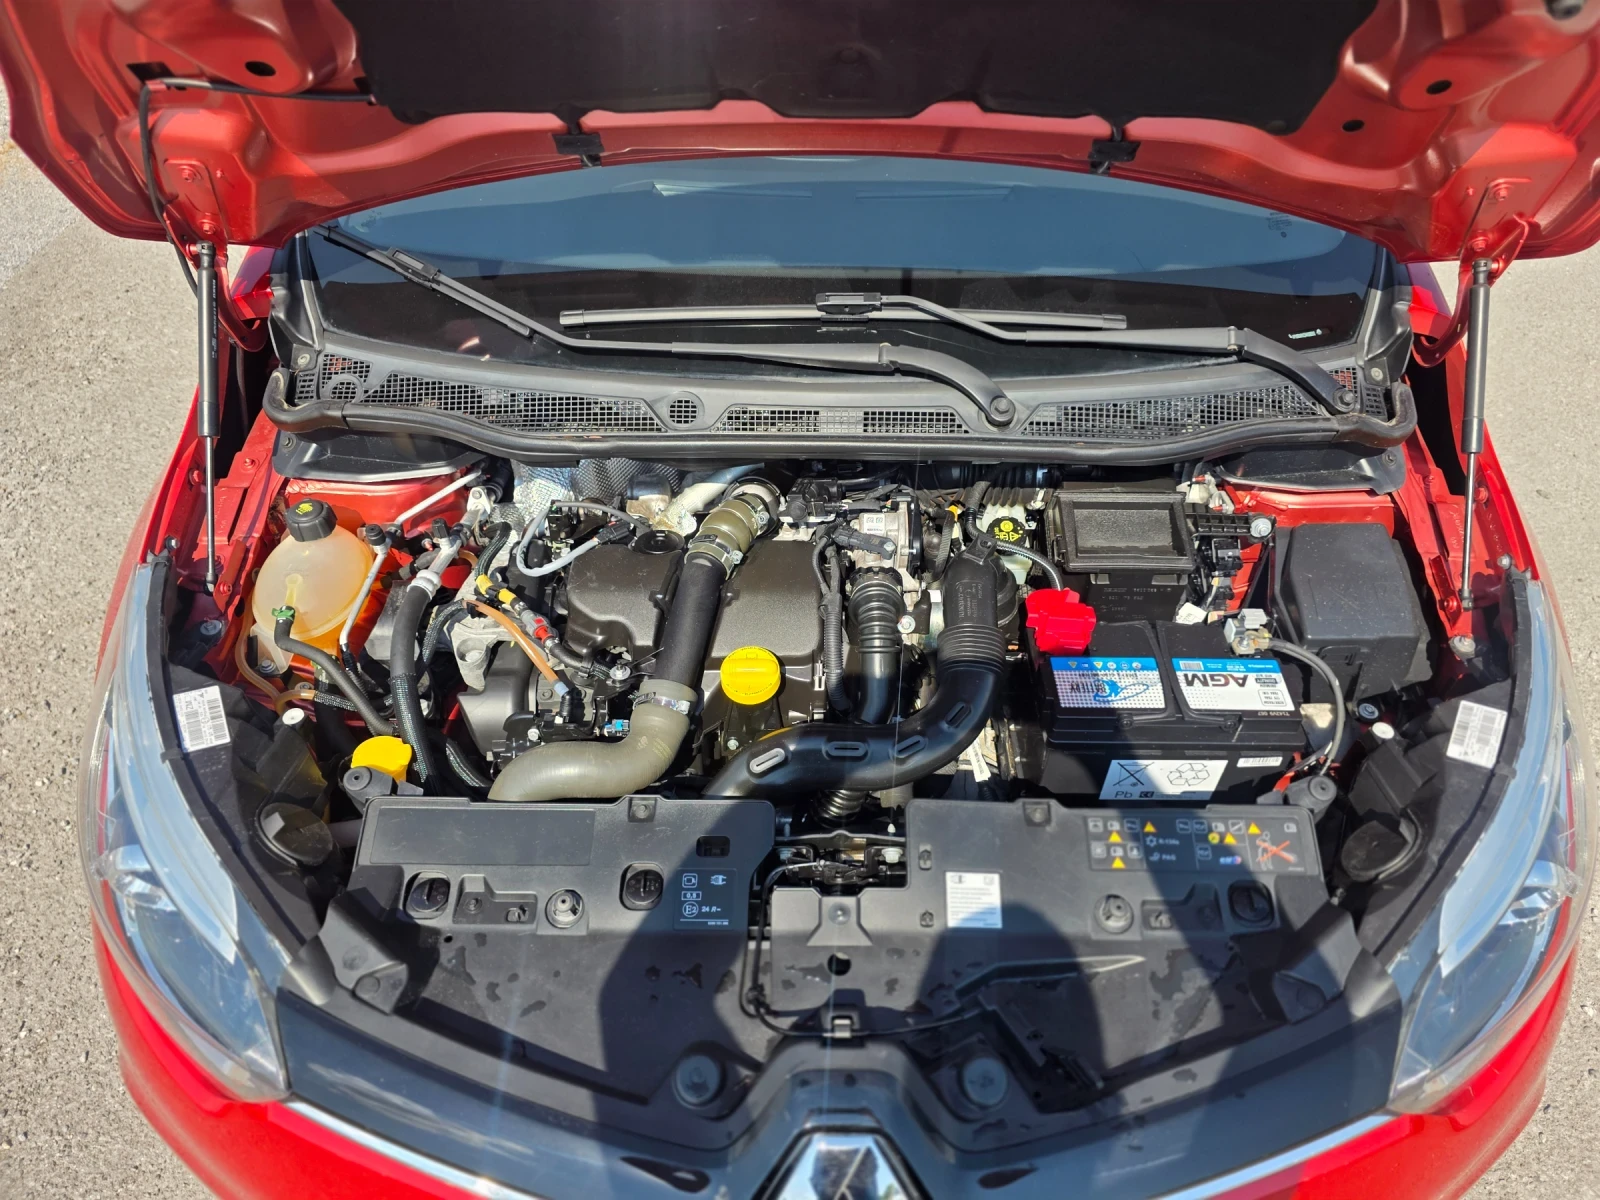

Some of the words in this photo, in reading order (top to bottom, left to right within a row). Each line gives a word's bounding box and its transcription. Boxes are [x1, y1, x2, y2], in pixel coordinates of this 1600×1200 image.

[1184, 673, 1249, 688] AGM
[1070, 682, 1107, 694] BATTERY
[685, 905, 697, 914] E2
